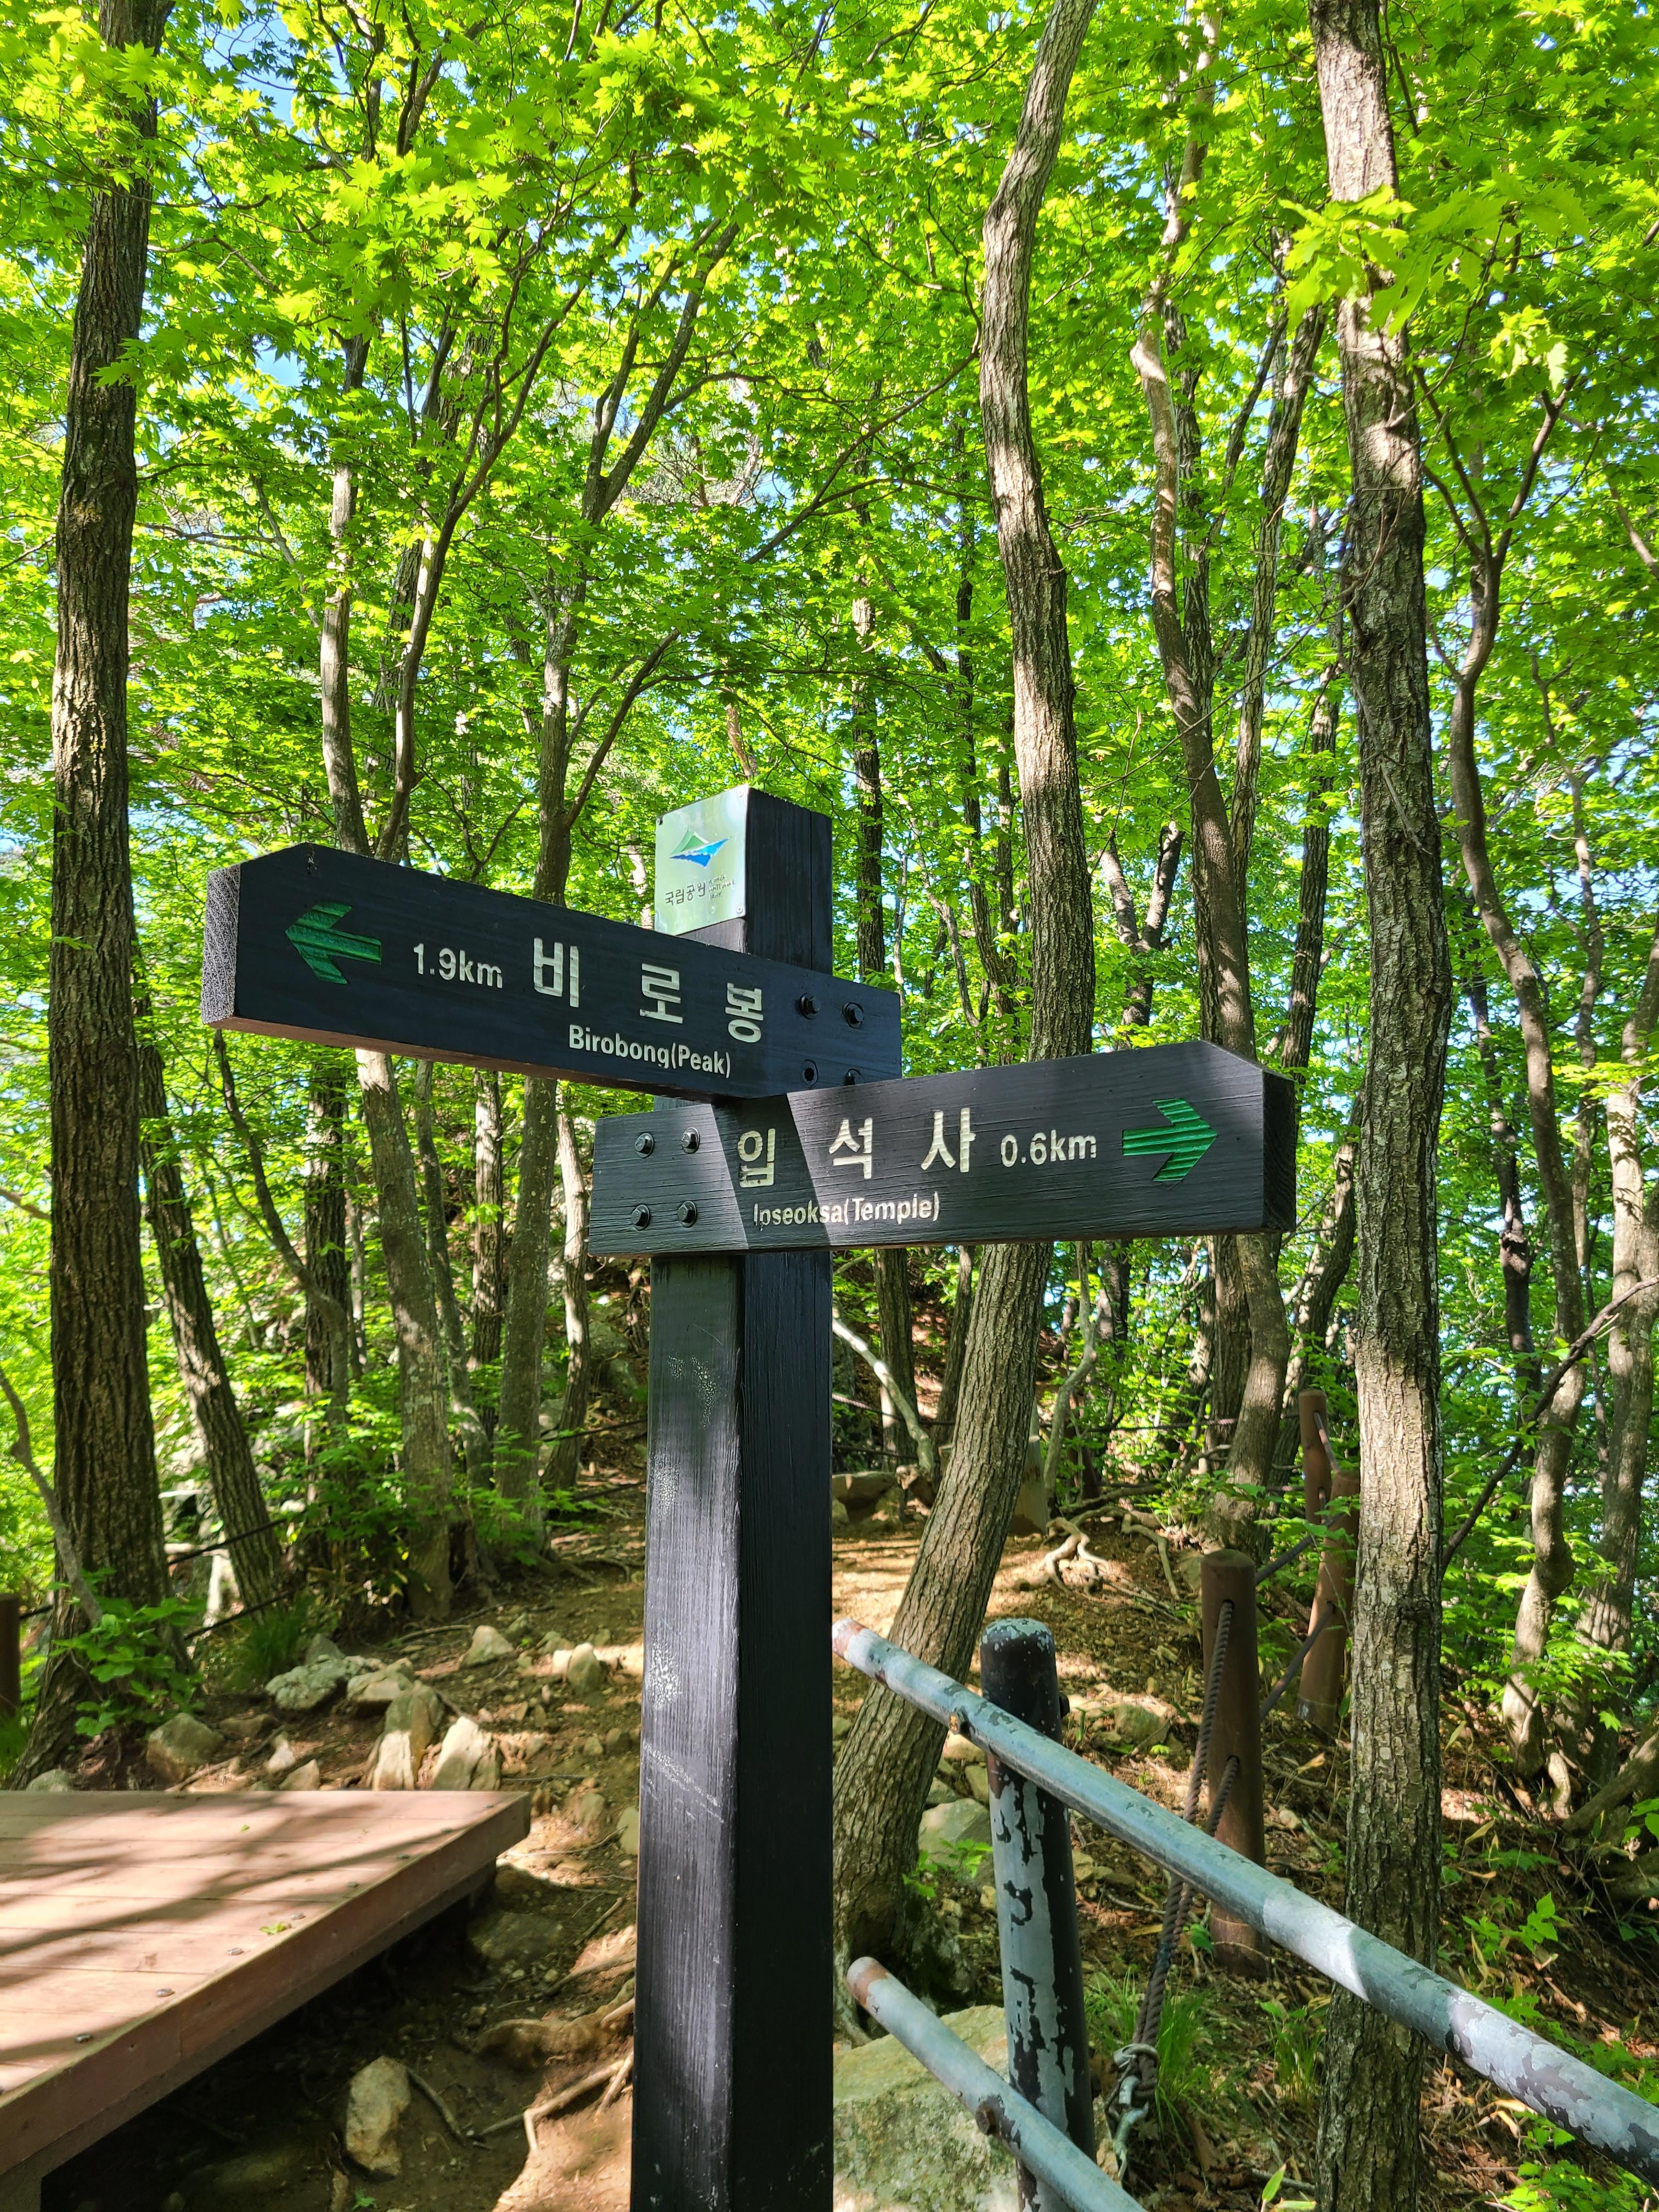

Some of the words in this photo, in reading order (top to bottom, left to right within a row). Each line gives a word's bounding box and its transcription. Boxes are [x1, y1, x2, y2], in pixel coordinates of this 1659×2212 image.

[665, 882, 706, 906] 국립공원
[414, 943, 503, 989] 1.9km
[568, 1024, 731, 1079] Birobong(Peak)
[1000, 1130, 1097, 1167] 0.6km
